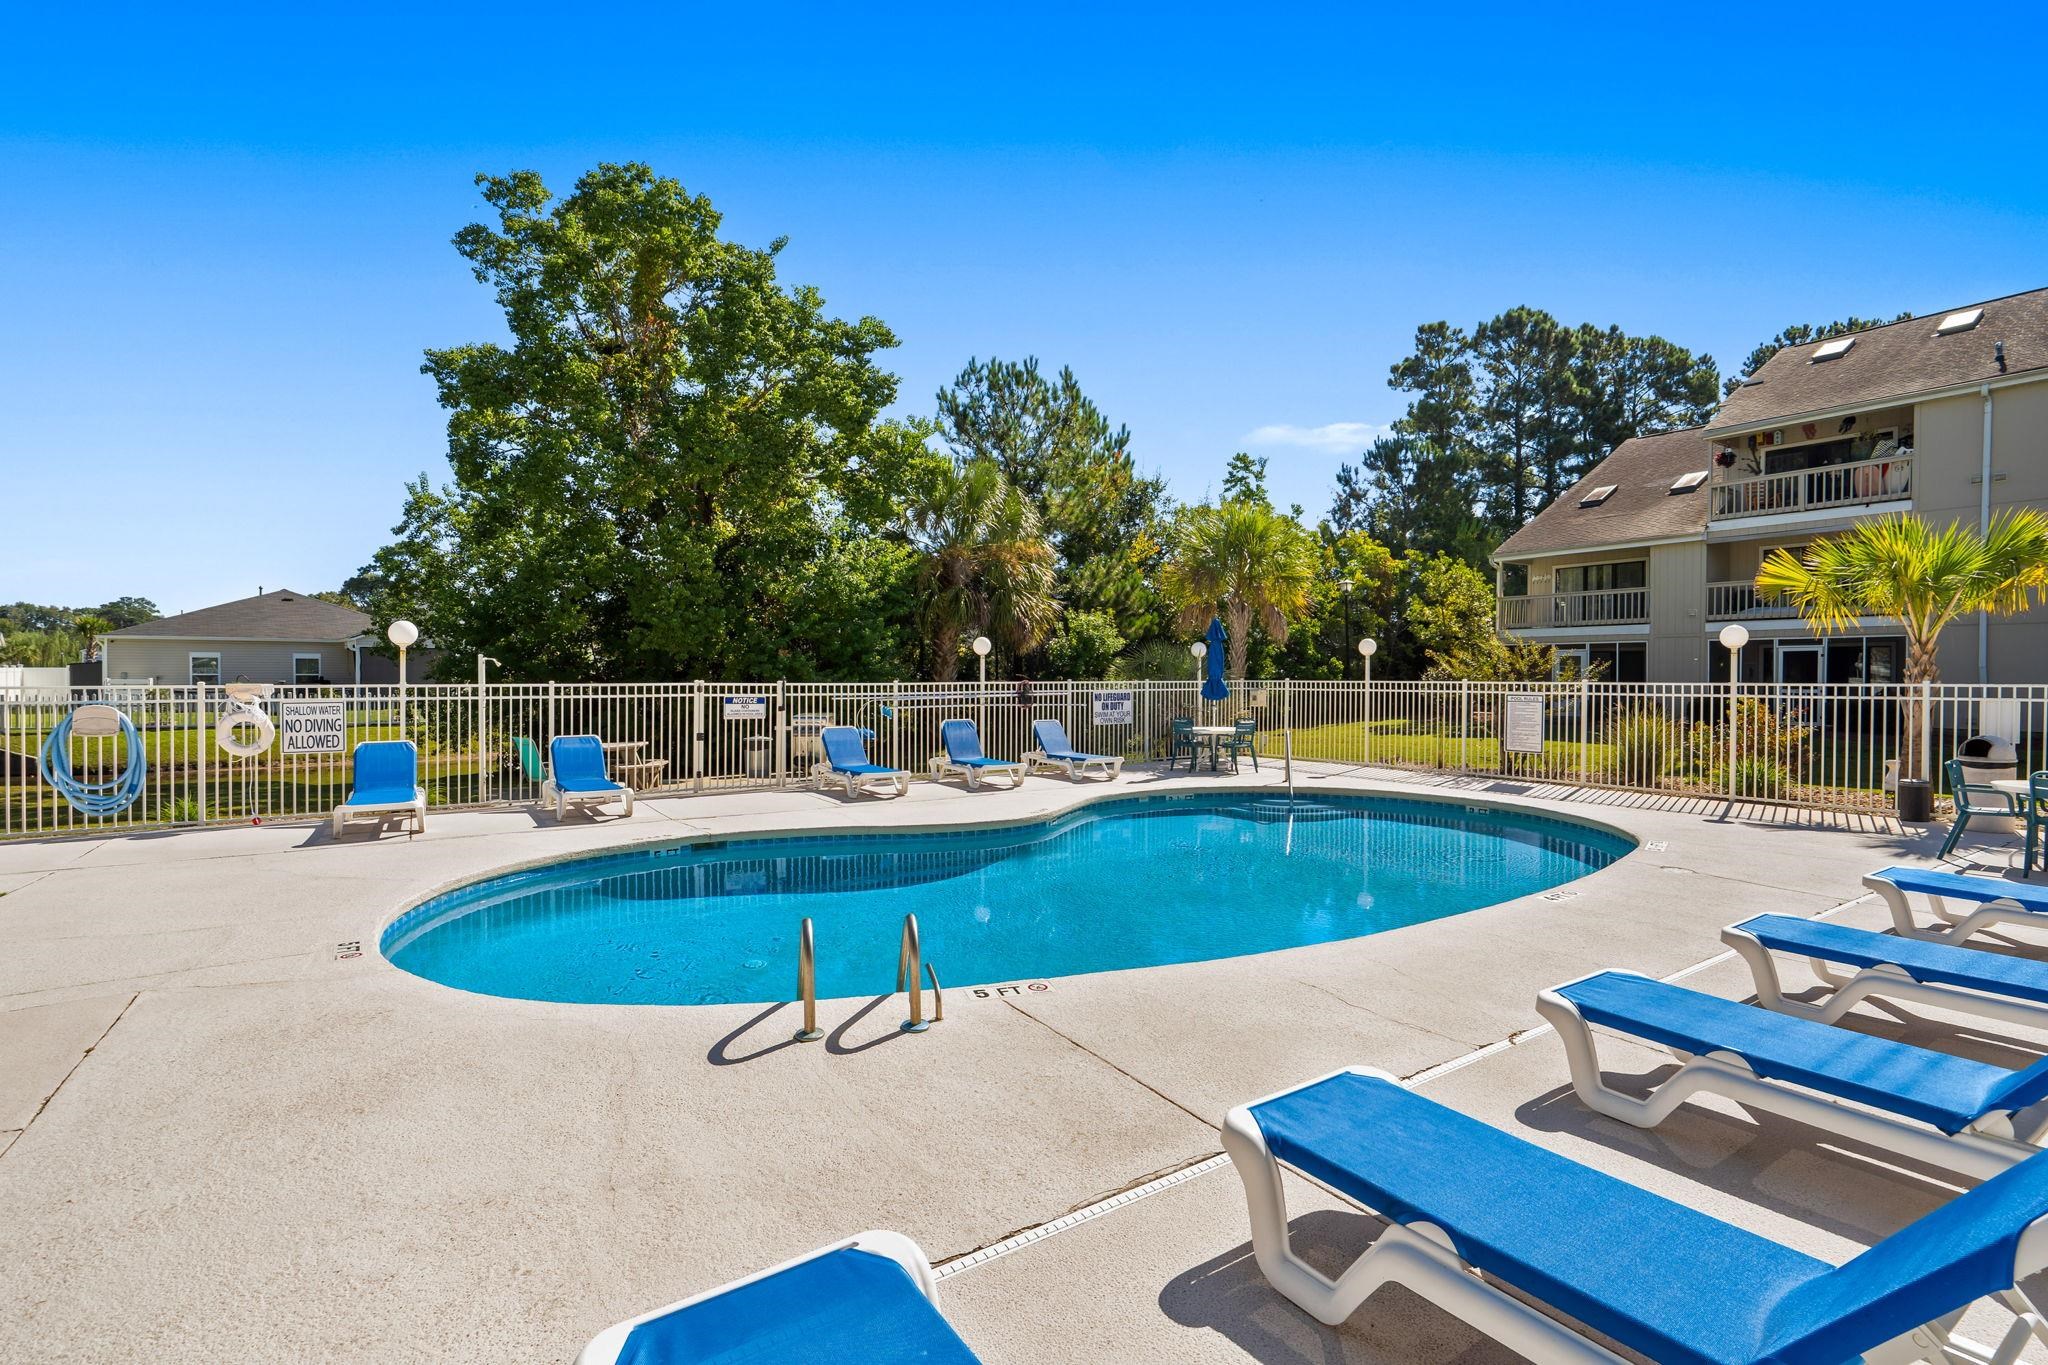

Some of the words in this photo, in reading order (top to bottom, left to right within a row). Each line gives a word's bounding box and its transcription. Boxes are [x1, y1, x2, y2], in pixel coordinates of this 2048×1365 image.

[1094, 693, 1102, 701] NO
[1103, 692, 1130, 701] LIFEGUARD
[286, 706, 317, 715] SHALLOW
[318, 705, 341, 715] WATER
[1102, 702, 1109, 710] ON
[1110, 702, 1124, 710] DUTY
[285, 719, 302, 733] NO
[305, 718, 342, 732] DIVING
[287, 735, 340, 749] ALLOWED
[973, 989, 990, 998] 5
[996, 985, 1021, 996] FT
